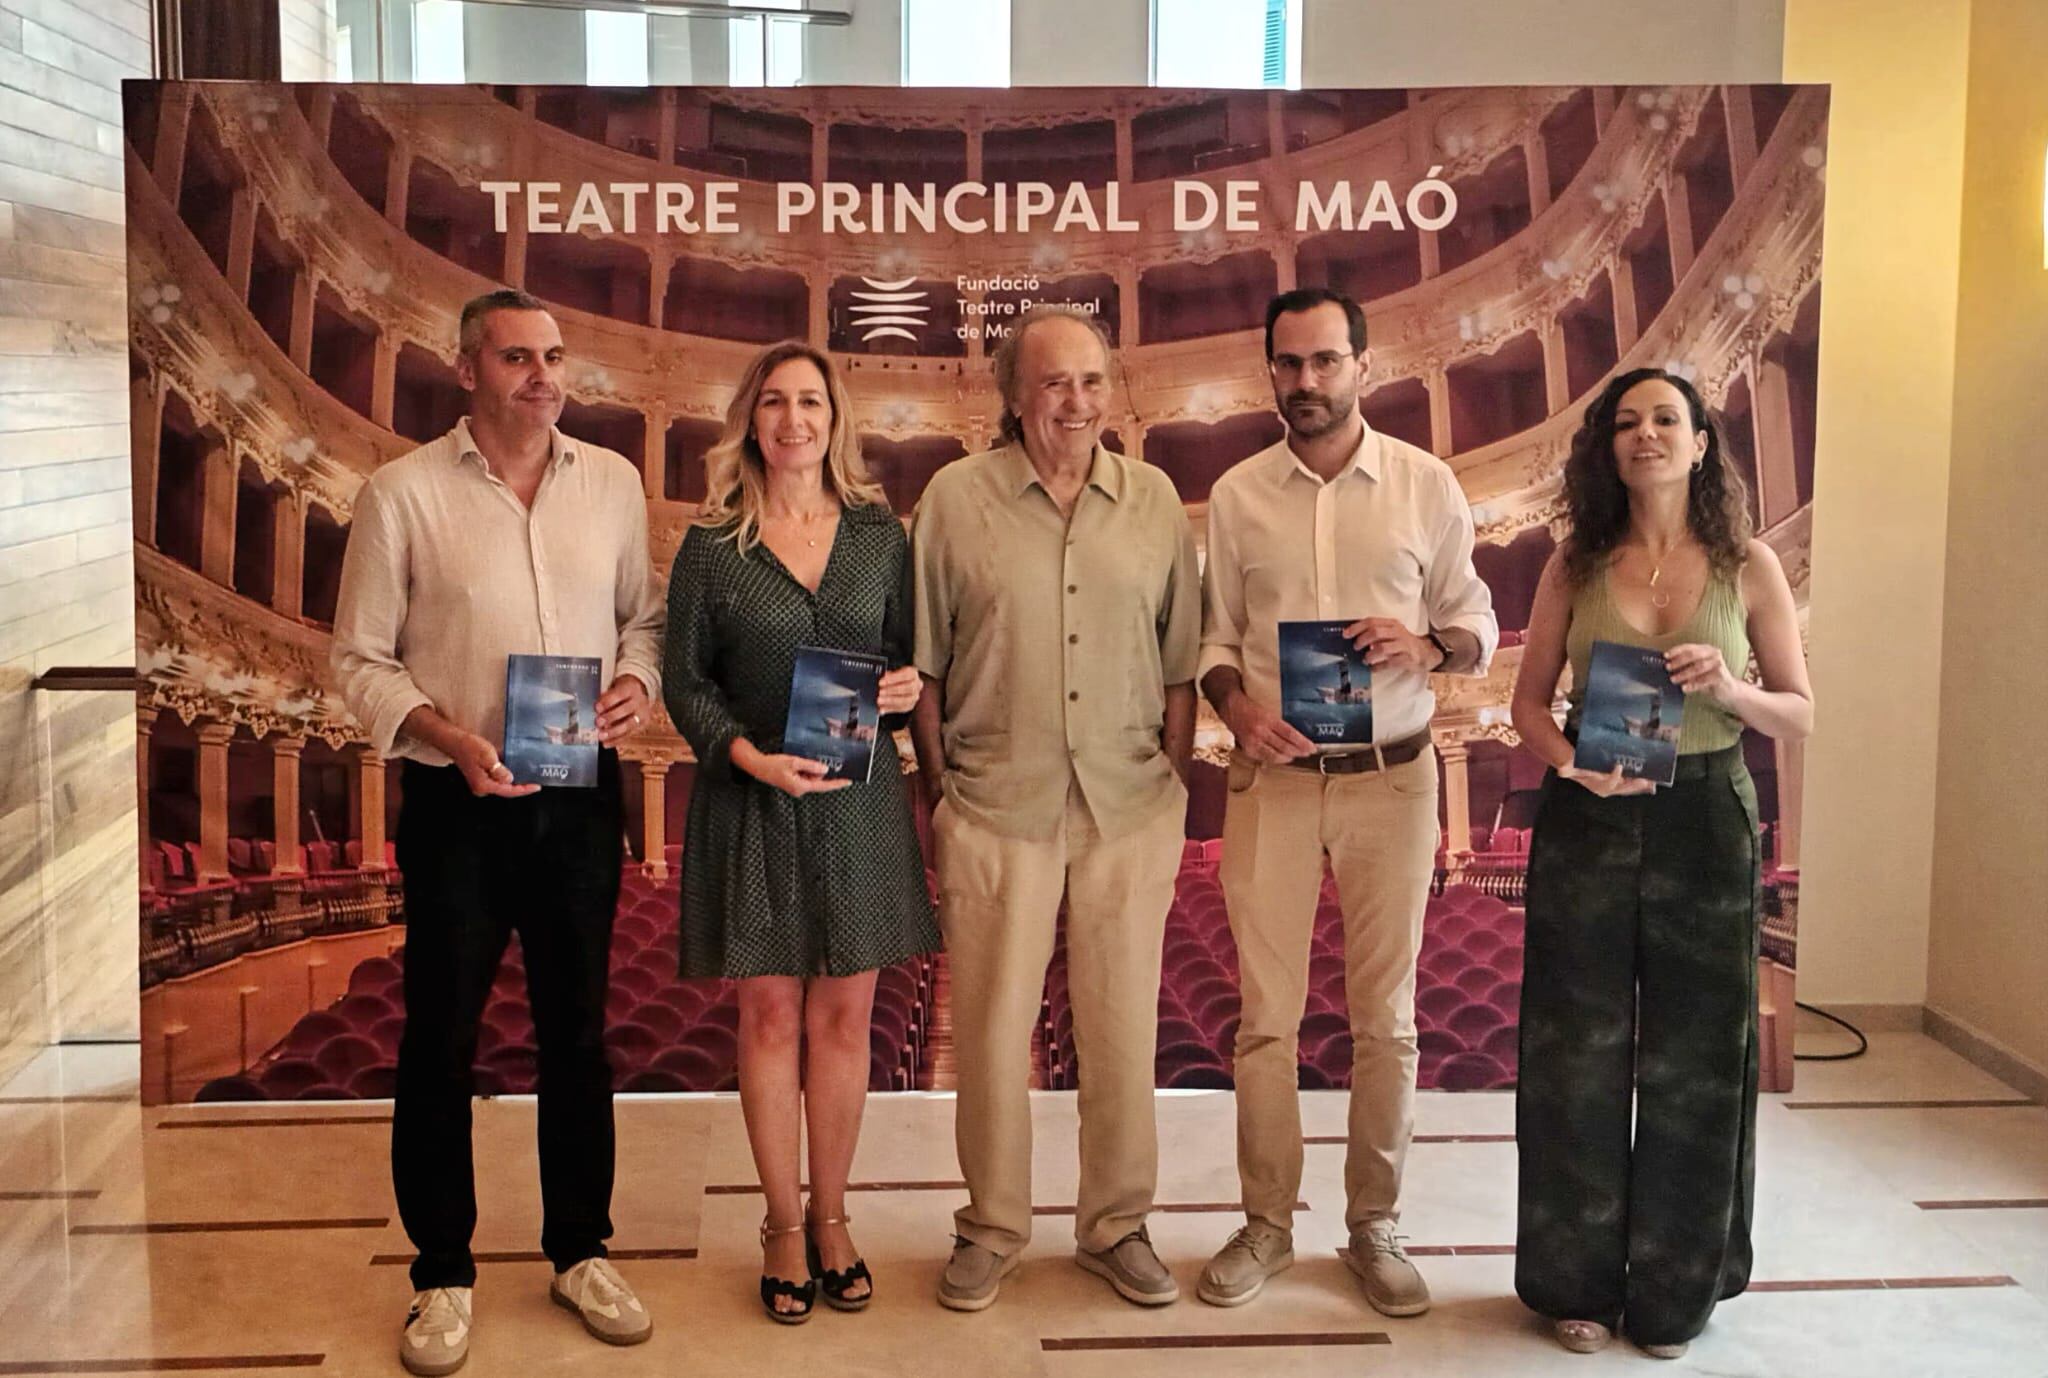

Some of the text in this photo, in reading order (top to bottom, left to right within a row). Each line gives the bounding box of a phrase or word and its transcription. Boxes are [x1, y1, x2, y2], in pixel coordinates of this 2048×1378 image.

[480, 165, 1458, 235] TEATRE PRINCIPAL DE MAÓ
[956, 274, 1040, 291] Fundació
[956, 299, 1015, 315] Teatre
[956, 322, 980, 340] de
